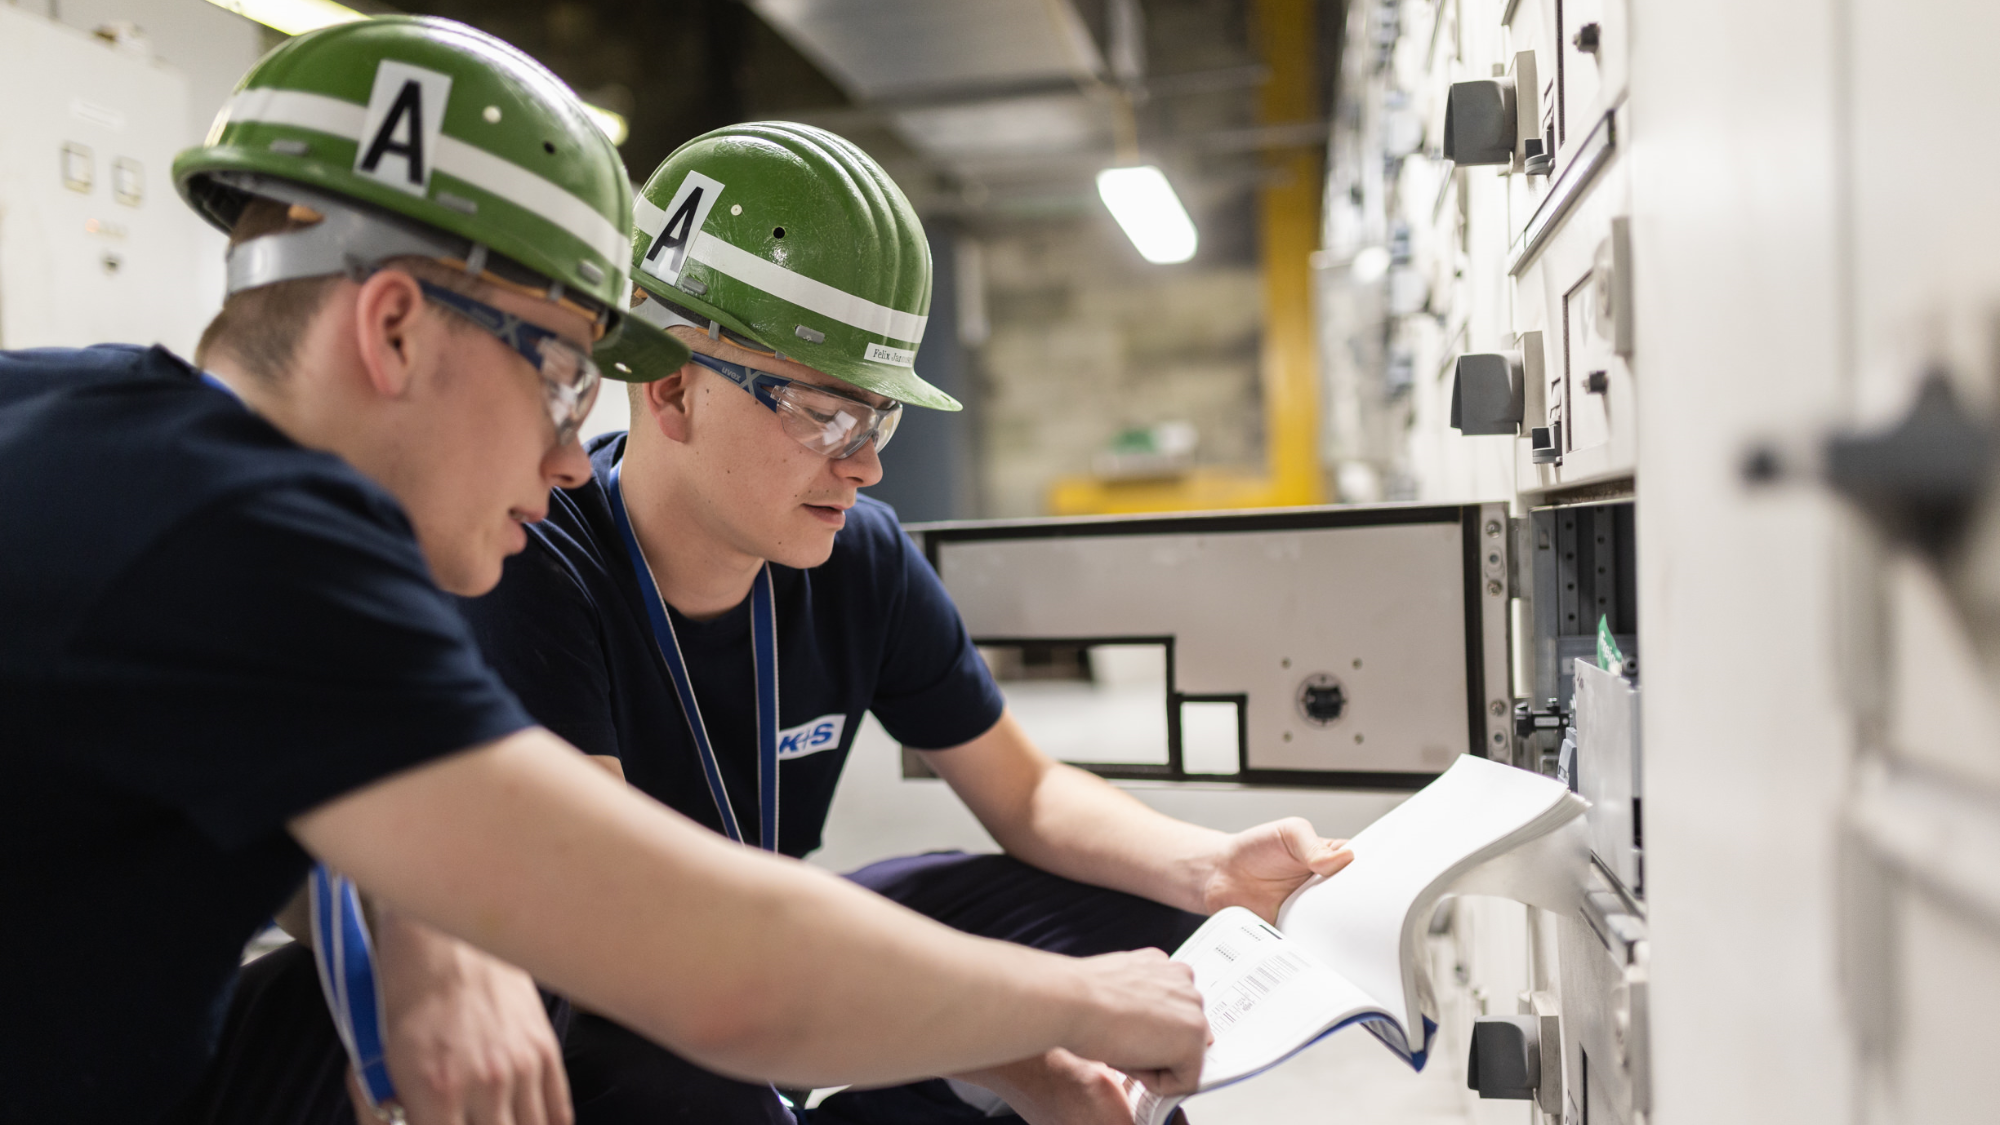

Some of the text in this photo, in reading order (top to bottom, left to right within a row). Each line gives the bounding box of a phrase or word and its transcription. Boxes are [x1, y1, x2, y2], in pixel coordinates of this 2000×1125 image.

[361, 79, 423, 186] A
[646, 186, 704, 273] A
[873, 349, 890, 360] Felix
[721, 366, 741, 382] uvex
[779, 723, 834, 754] K+S
